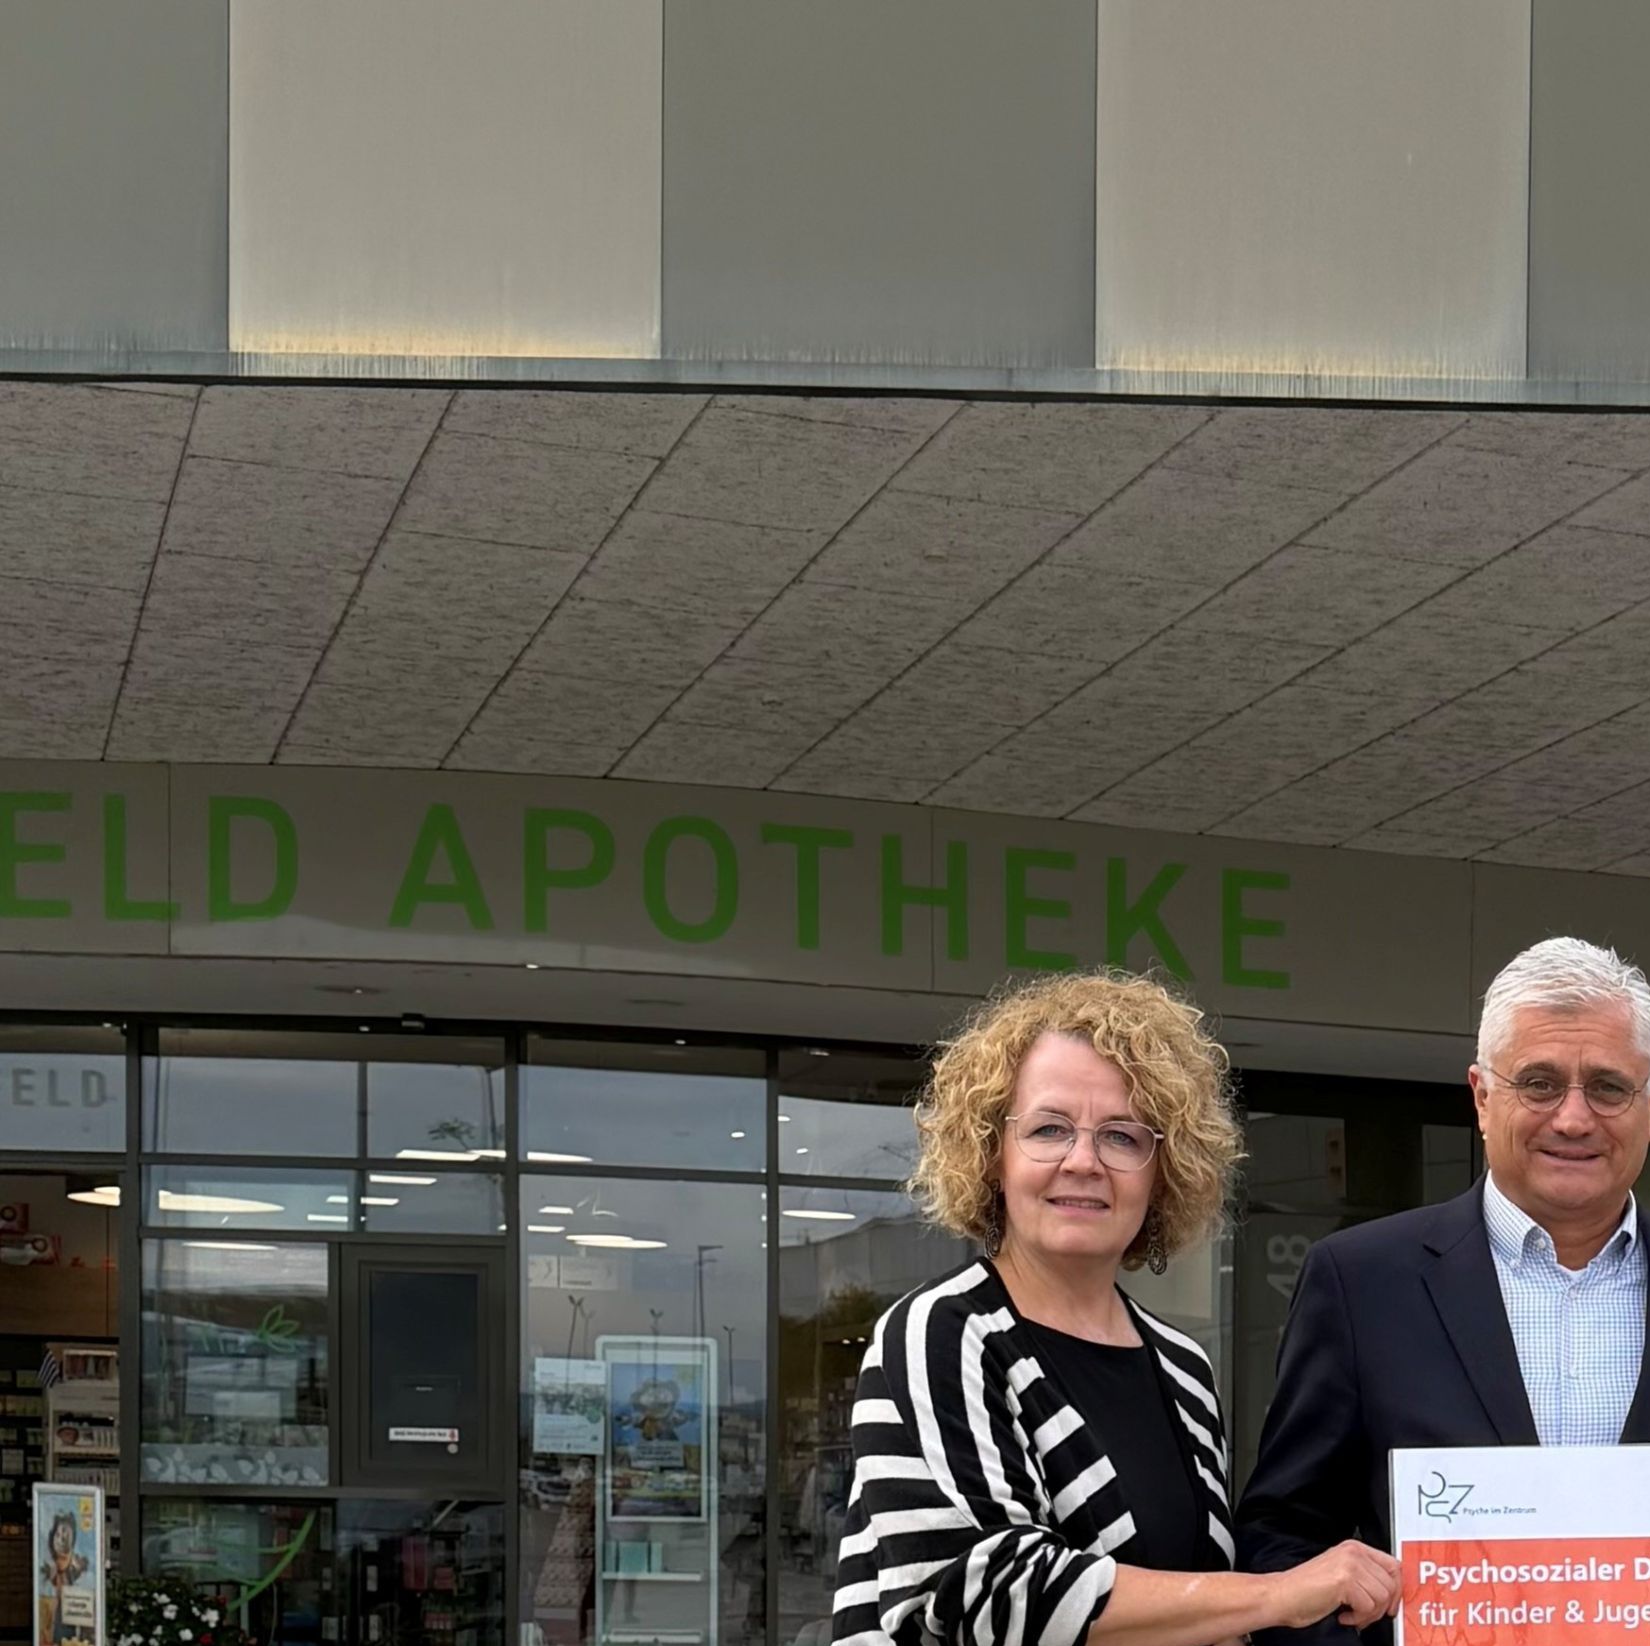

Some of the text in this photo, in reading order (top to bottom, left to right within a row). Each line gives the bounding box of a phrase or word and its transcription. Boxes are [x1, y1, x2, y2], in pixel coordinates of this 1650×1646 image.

[387, 802, 1292, 990] APOTHEKE
[1419, 1557, 1626, 1591] Psychosozialer
[1419, 1601, 1458, 1626] für
[1468, 1600, 1556, 1625] Kinder
[1564, 1600, 1584, 1623] &
